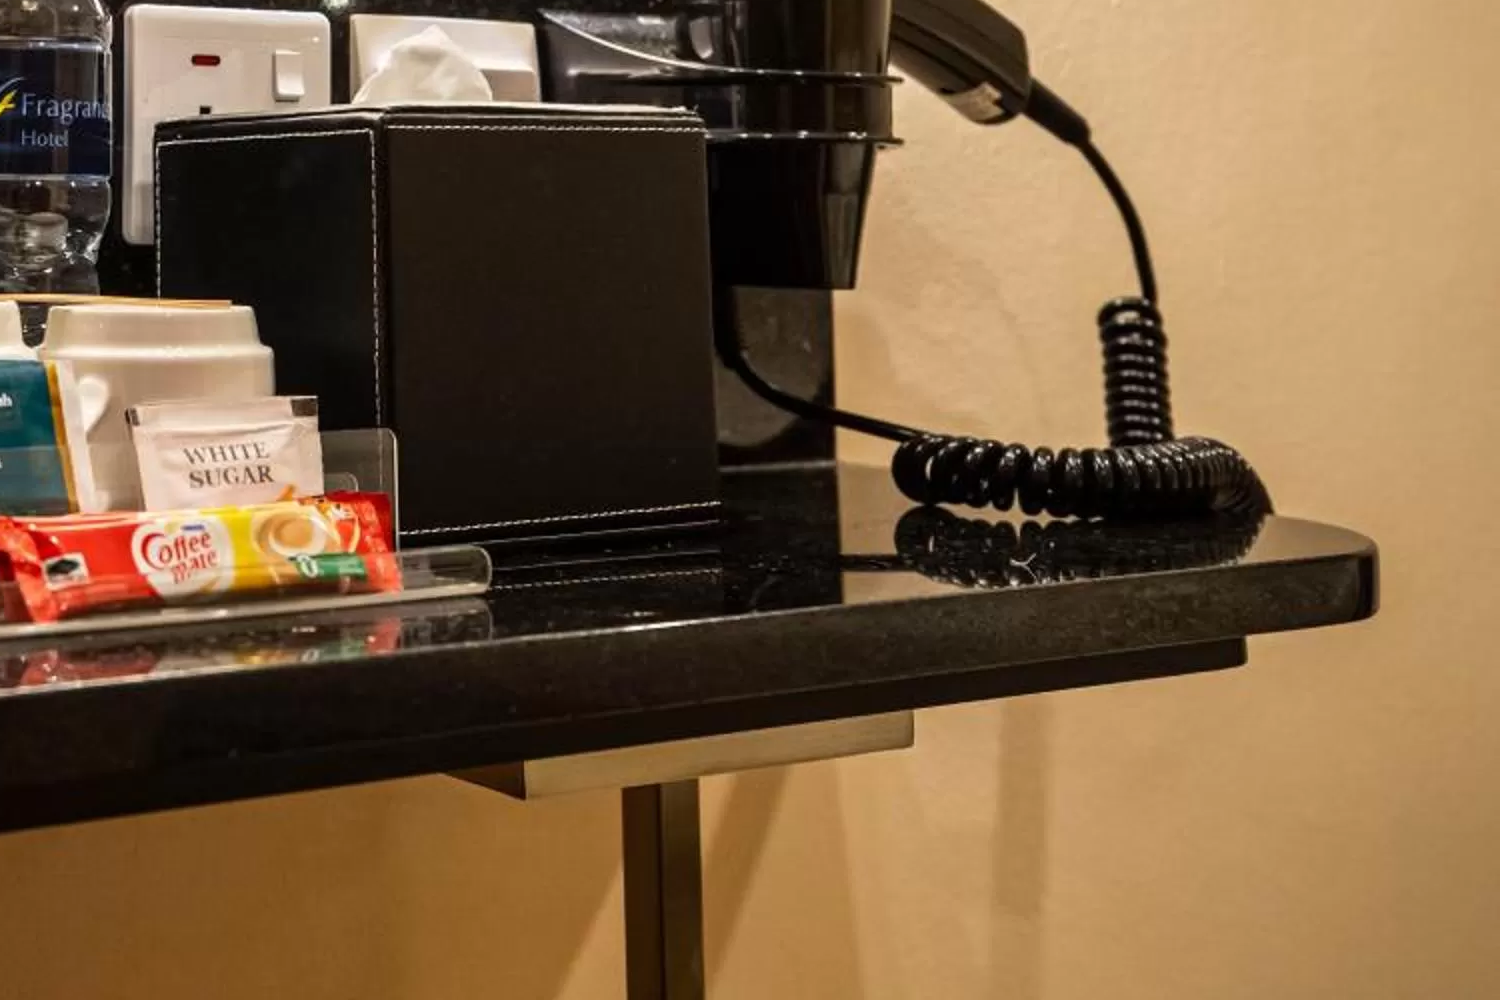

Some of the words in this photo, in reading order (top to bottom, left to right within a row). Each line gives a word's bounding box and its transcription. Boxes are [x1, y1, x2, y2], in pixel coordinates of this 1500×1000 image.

[21, 129, 69, 147] Hotel
[183, 442, 270, 464] WHITE
[189, 463, 275, 489] SUGAR
[141, 532, 211, 572] Coffee
